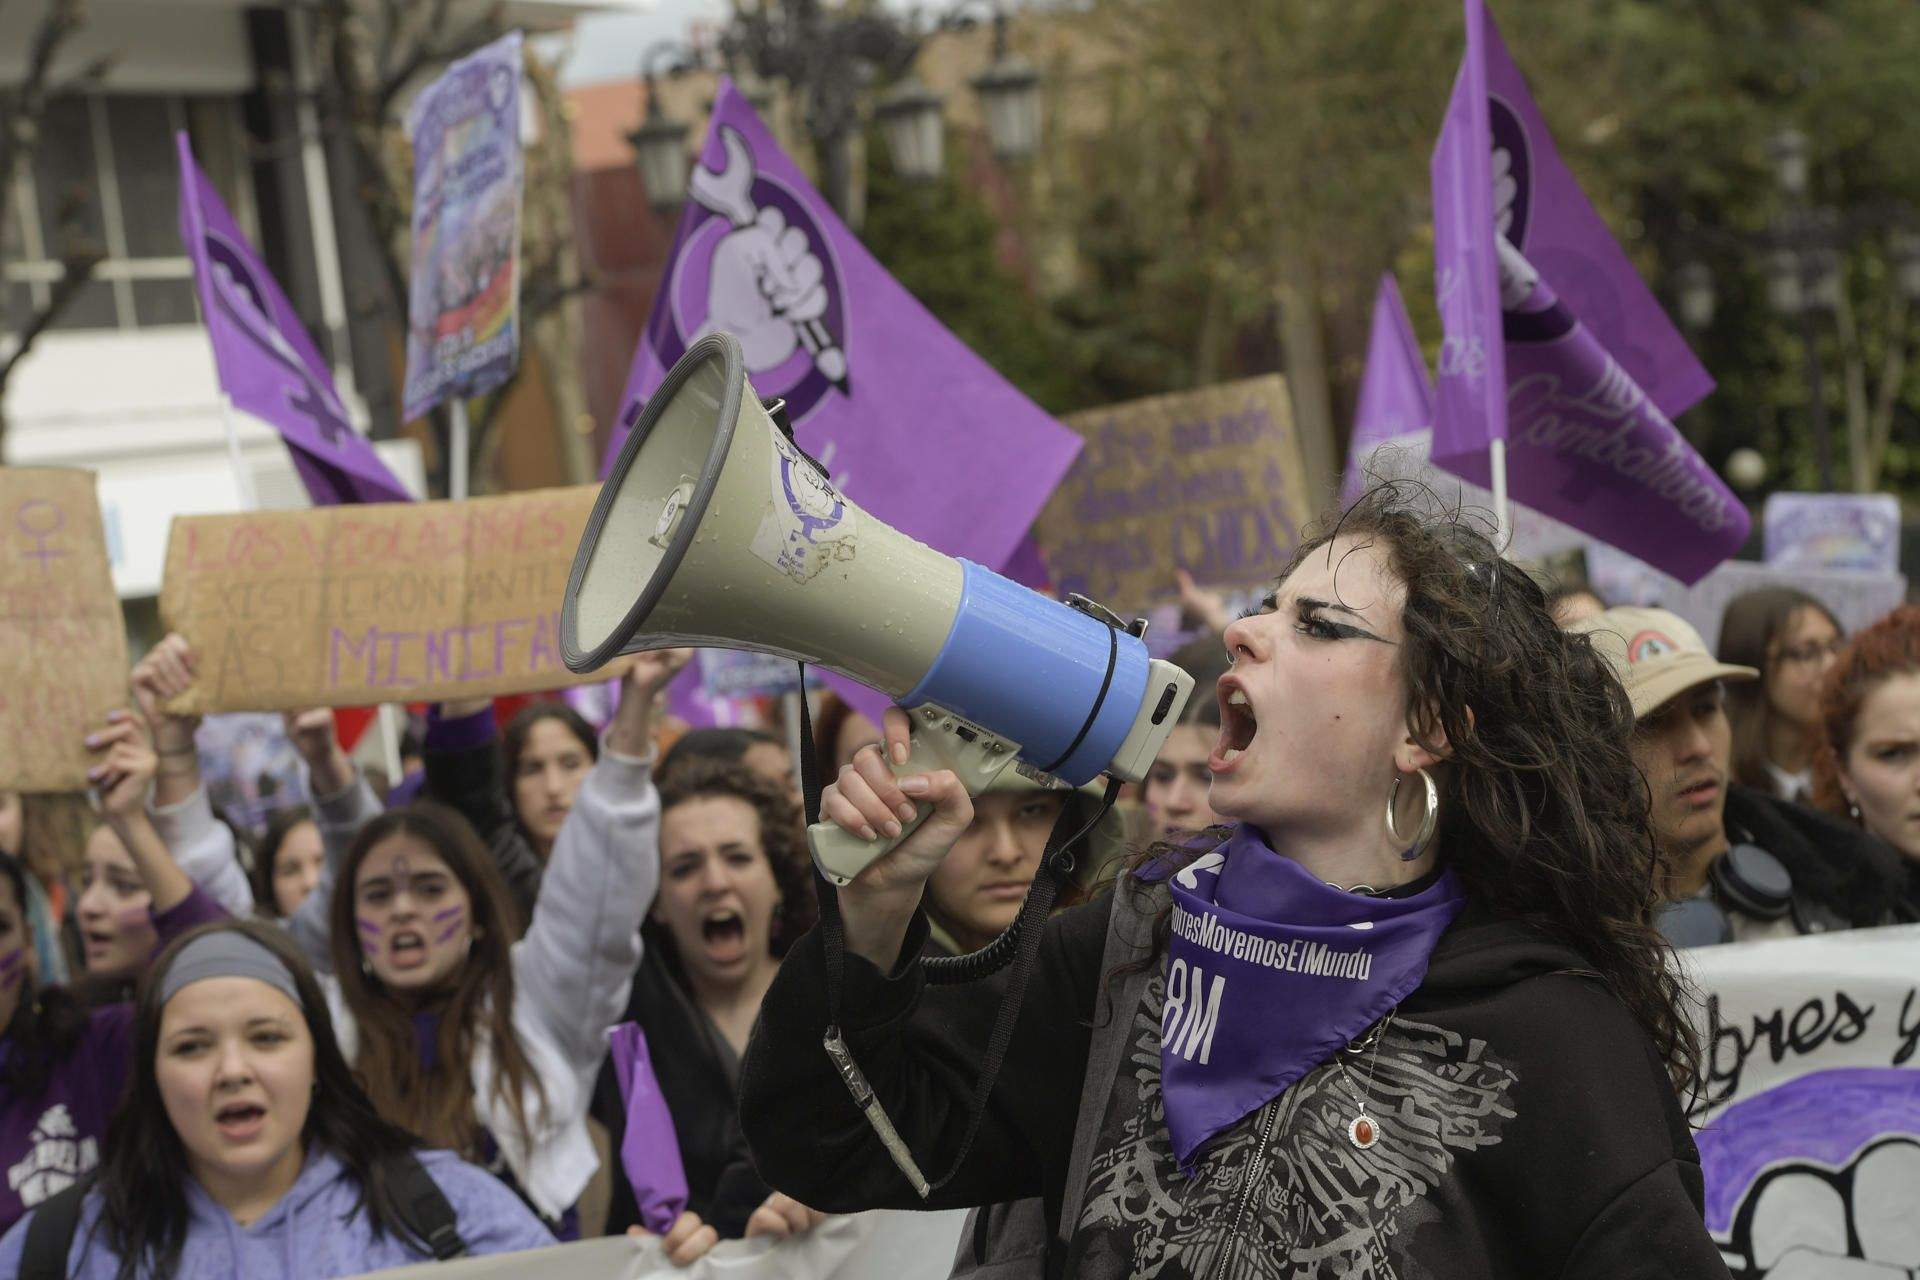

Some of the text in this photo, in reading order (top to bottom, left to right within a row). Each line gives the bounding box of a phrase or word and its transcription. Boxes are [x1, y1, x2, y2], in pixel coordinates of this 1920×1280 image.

[186, 522, 287, 572] LOS
[467, 560, 563, 605] ANTE
[1160, 958, 1227, 1066] 8M
[1701, 991, 1876, 1100] bres
